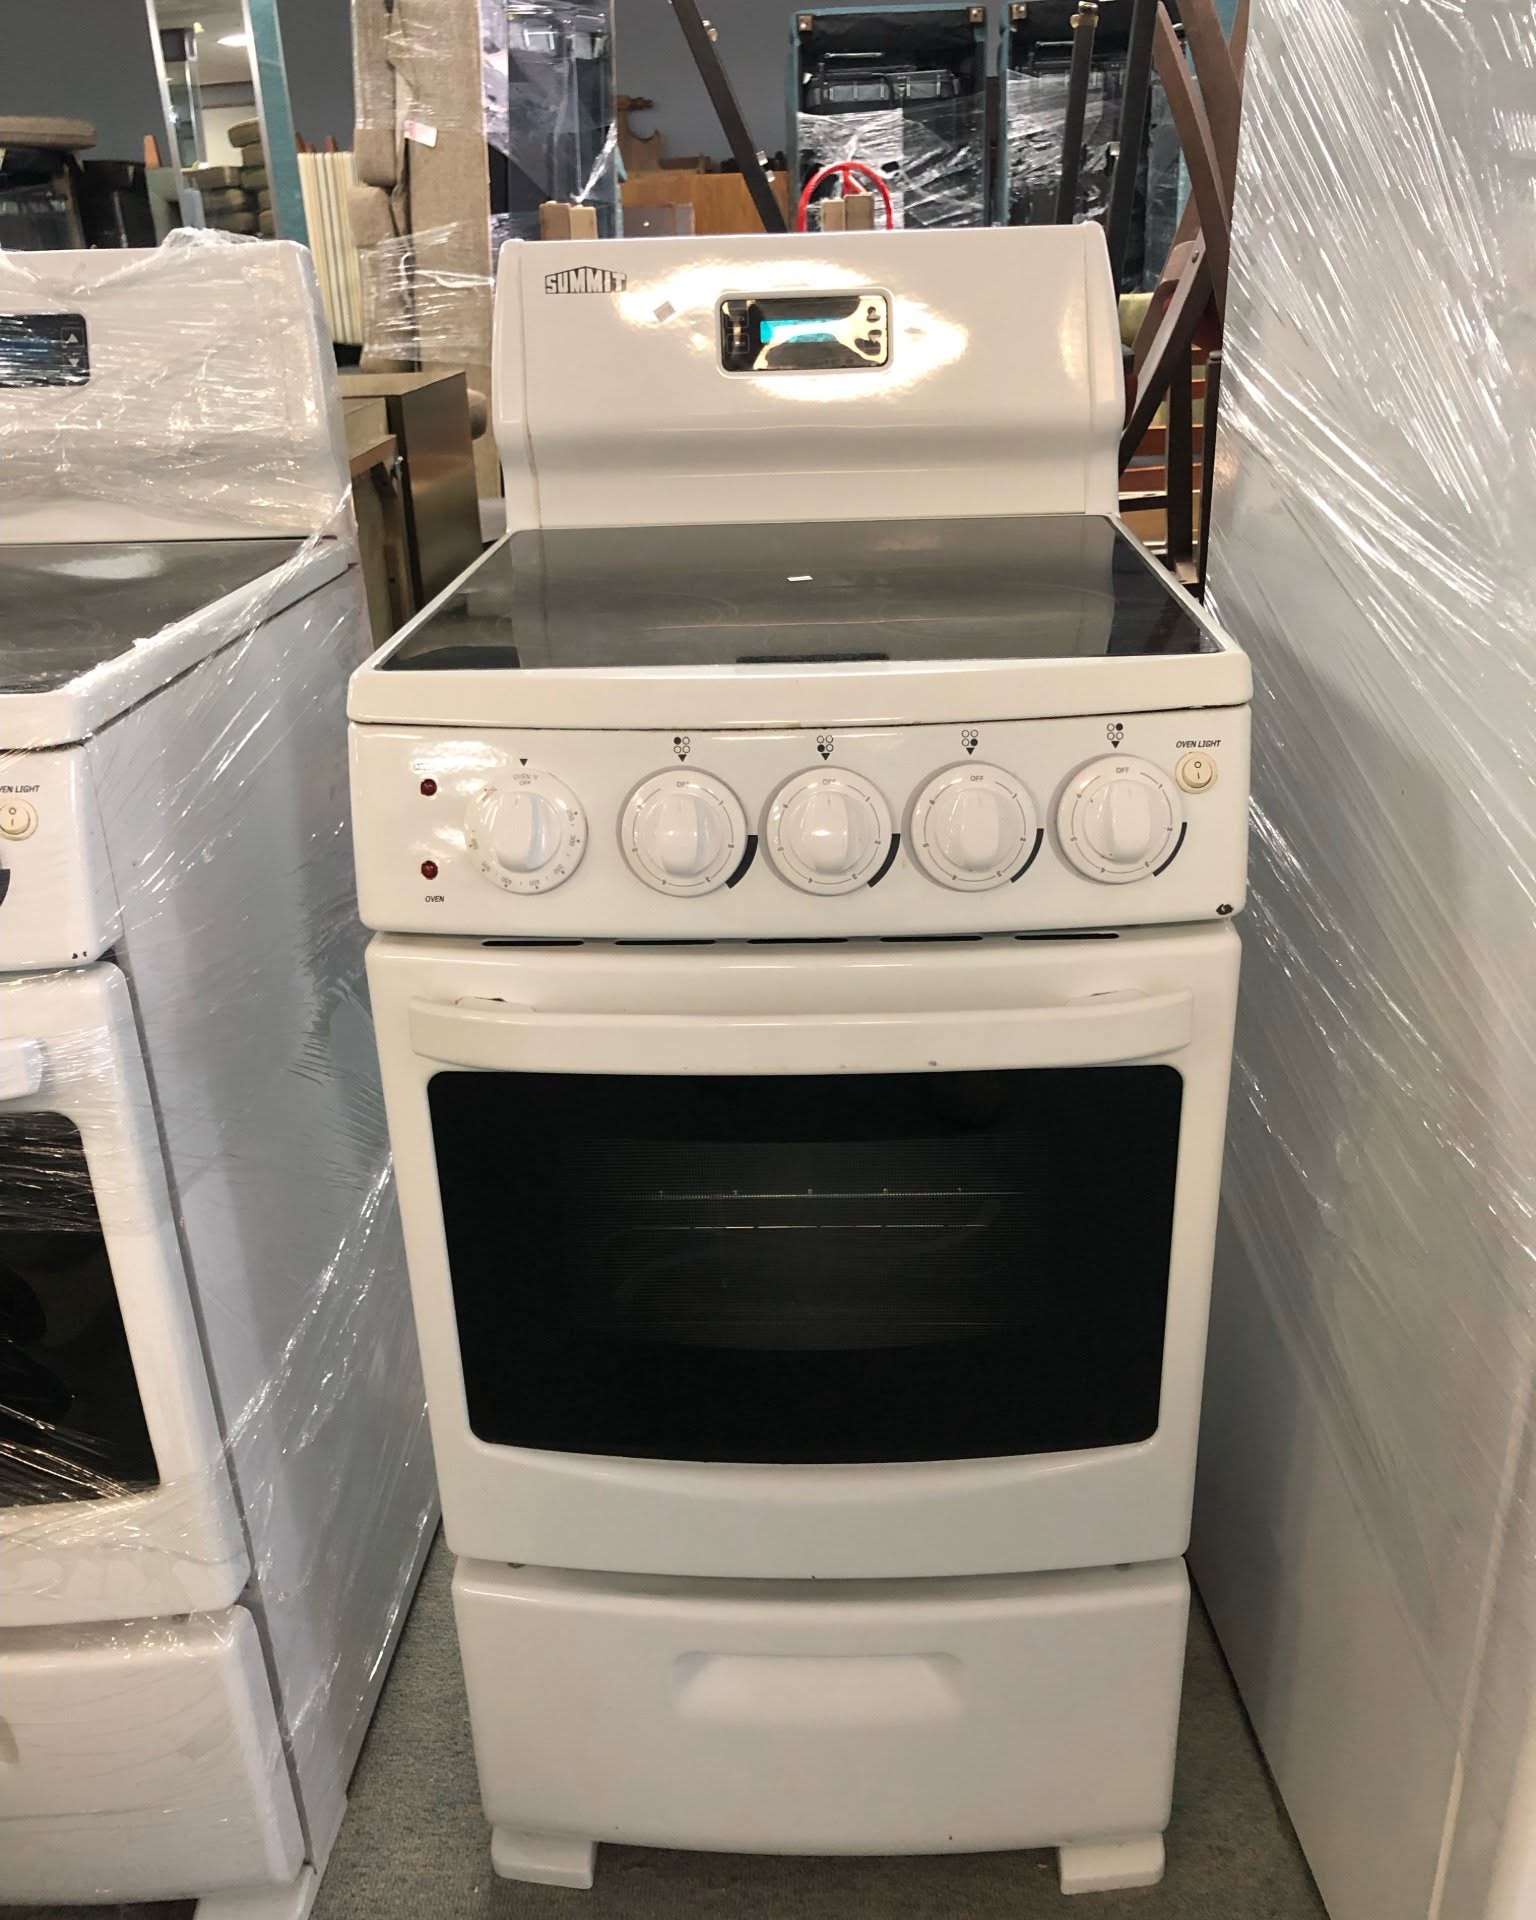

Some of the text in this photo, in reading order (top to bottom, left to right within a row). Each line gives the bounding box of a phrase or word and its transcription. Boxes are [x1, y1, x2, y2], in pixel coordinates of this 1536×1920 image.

[545, 266, 627, 294] SUMMIT
[1175, 739, 1222, 749] OVEN LIGHT
[15, 784, 40, 793] LIGHT
[424, 895, 445, 903] OVEN
